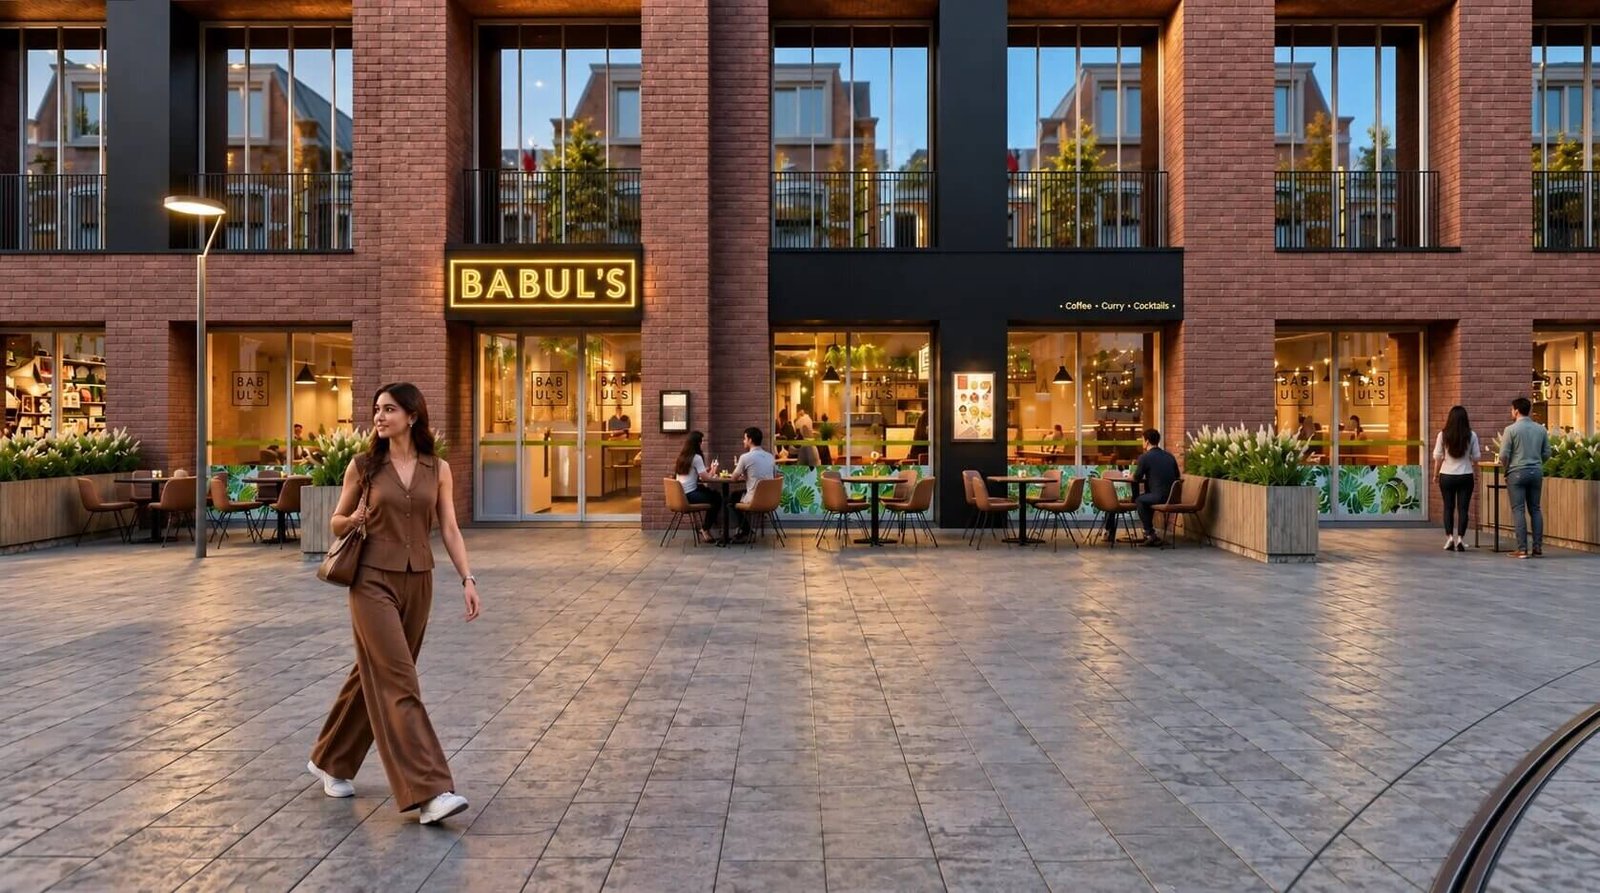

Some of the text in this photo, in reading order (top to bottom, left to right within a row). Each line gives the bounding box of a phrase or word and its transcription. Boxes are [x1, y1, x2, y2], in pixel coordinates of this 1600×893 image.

[461, 268, 626, 299] BABUL'S
[1065, 301, 1169, 312] Coffee Curry Cocktails
[237, 376, 264, 387] BAB
[536, 376, 563, 387] BAB
[601, 376, 627, 387] BAB
[1281, 376, 1309, 386] BAB
[1544, 376, 1573, 387] BAB
[237, 390, 265, 400] UL'S
[536, 390, 563, 400] UL'S
[601, 390, 628, 400] UL'S
[865, 390, 893, 400] UL'S
[1281, 390, 1309, 400] UL'S
[1358, 390, 1386, 400] UL'S
[1545, 390, 1573, 400] UL'S
